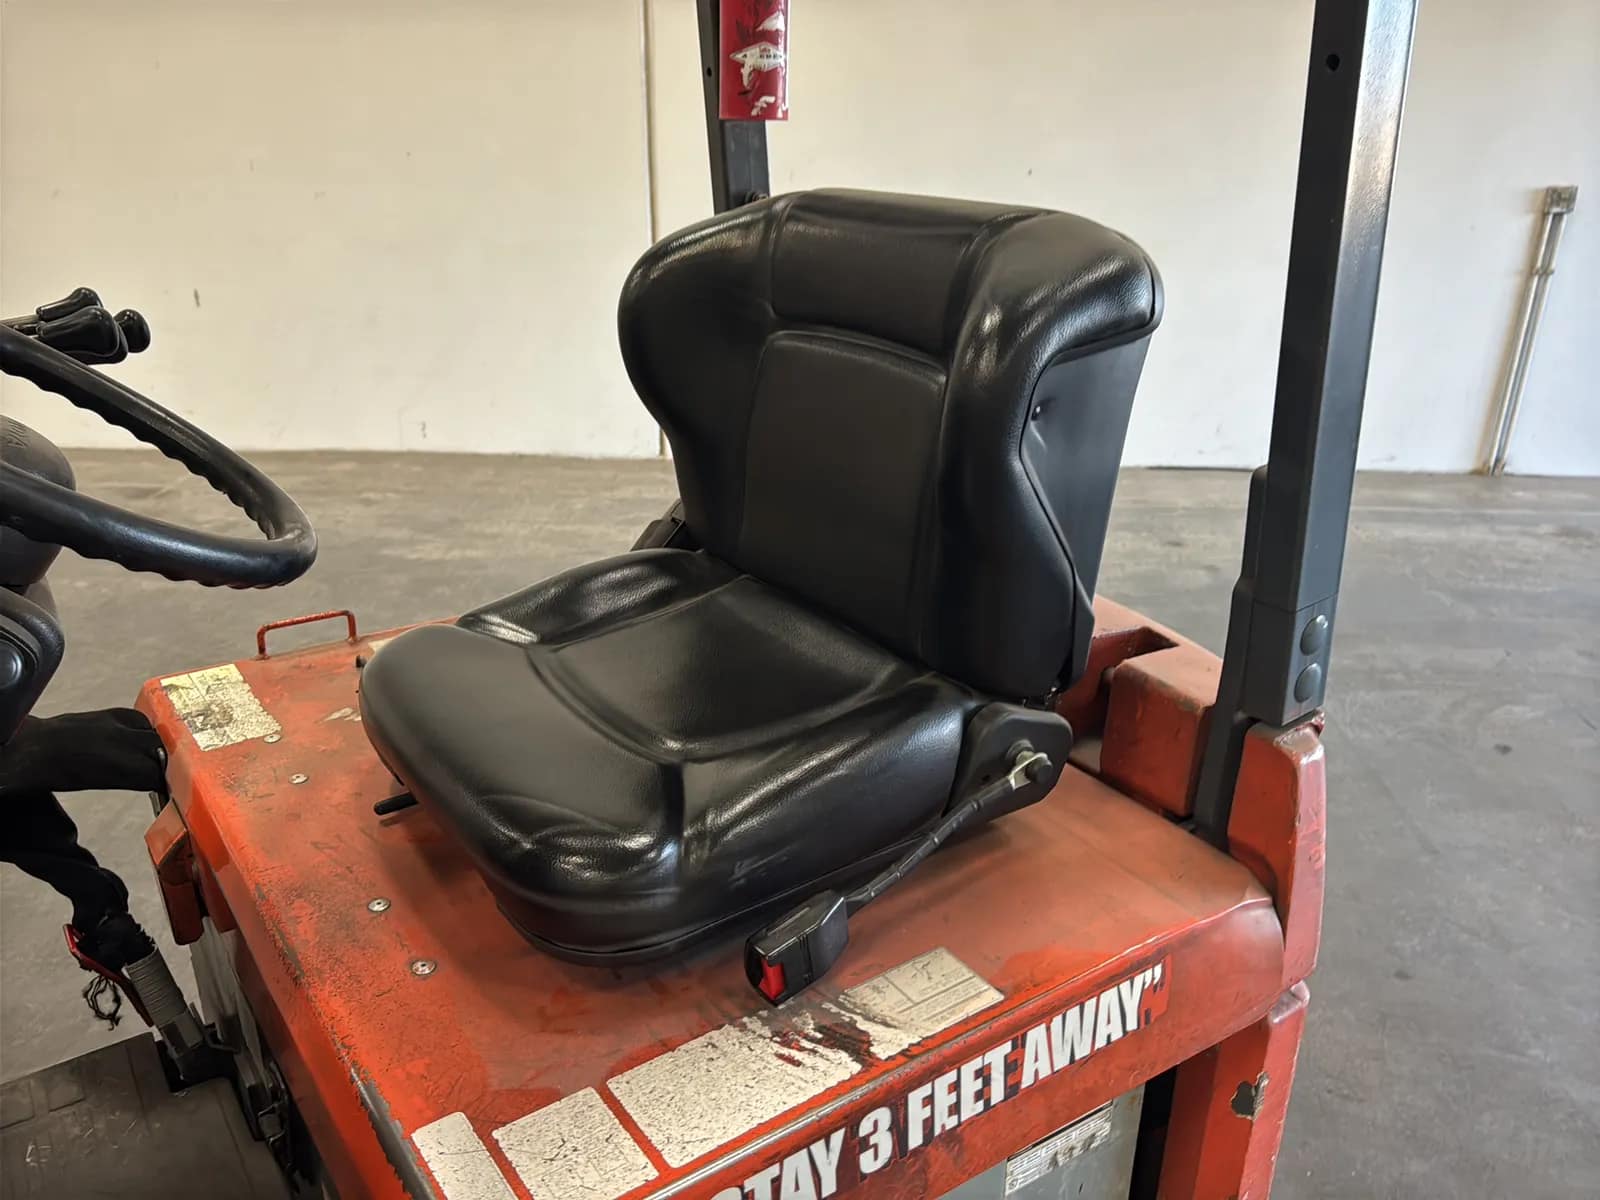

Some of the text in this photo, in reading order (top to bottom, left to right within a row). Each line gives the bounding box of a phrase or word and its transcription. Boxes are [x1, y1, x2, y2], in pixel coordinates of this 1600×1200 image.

[710, 1127, 846, 1200] TAY
[858, 1106, 893, 1174] 3
[907, 1040, 1012, 1151] FEET
